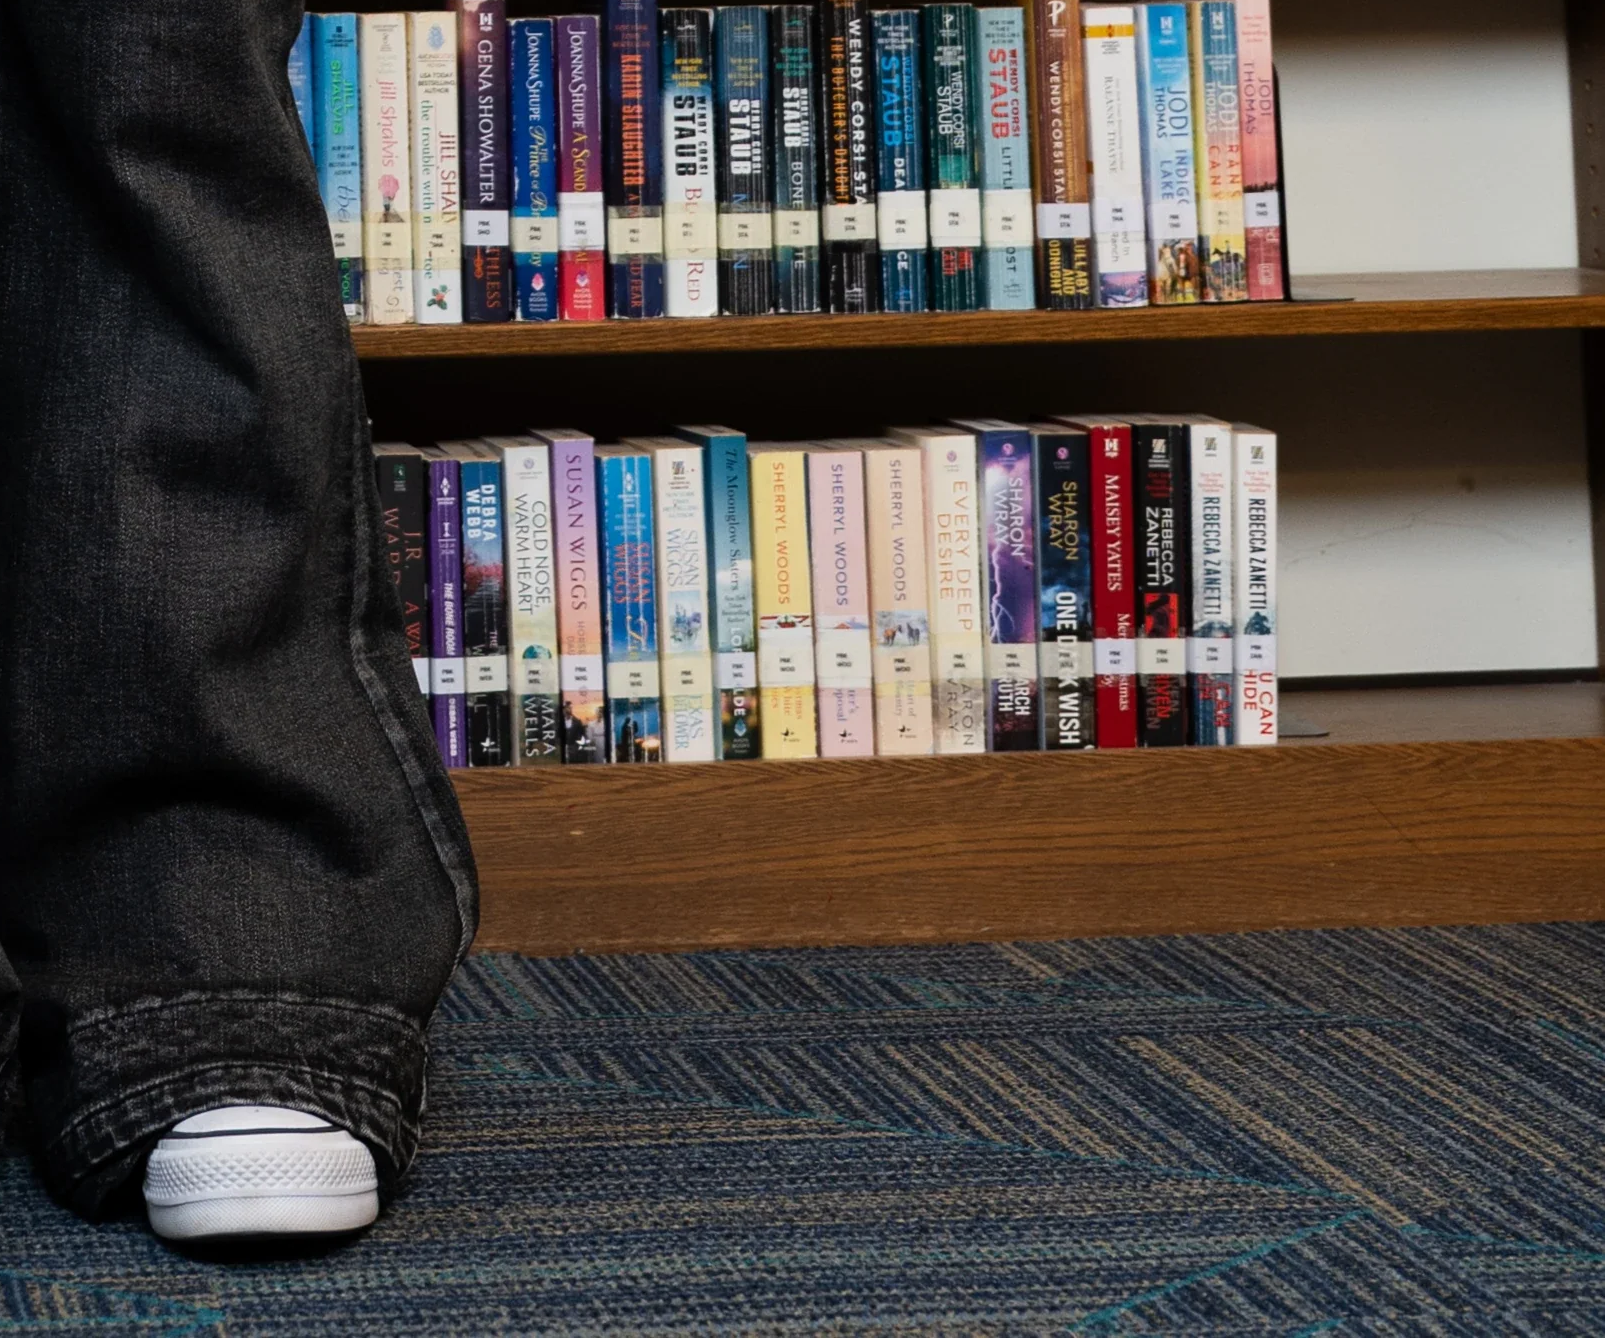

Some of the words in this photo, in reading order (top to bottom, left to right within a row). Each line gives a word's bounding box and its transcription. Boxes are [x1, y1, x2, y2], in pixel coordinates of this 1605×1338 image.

[478, 39, 494, 90] GENA
[620, 54, 641, 99] KARIN
[421, 100, 433, 121] the
[674, 95, 695, 176] STAUB
[1154, 87, 1167, 139] THOMAS
[1168, 86, 1188, 138] JODI
[422, 127, 434, 175] trouble
[479, 96, 494, 204] SHOWALTER
[622, 105, 643, 185] SLAUGHTER
[423, 181, 434, 211] with
[1160, 160, 1173, 201] LAKE
[725, 449, 738, 472] The
[566, 455, 584, 528] SUSAN
[726, 474, 739, 544] Moonglow
[831, 464, 846, 534] SHERRYL
[953, 481, 970, 558] EVERY
[514, 494, 532, 552] WARM
[531, 500, 548, 551] COLD
[1248, 496, 1266, 554] REBECCA
[531, 556, 550, 609] NOSE,
[569, 536, 587, 610] WIGGS
[729, 550, 741, 591] Sisters
[835, 541, 849, 606] WOODS
[937, 513, 954, 600] DESIRE
[1249, 557, 1267, 611] ZANETTI
[516, 557, 533, 615] HEART
[956, 569, 973, 631] DEEP
[523, 697, 540, 757] WELLS
[540, 699, 556, 755] MARA
